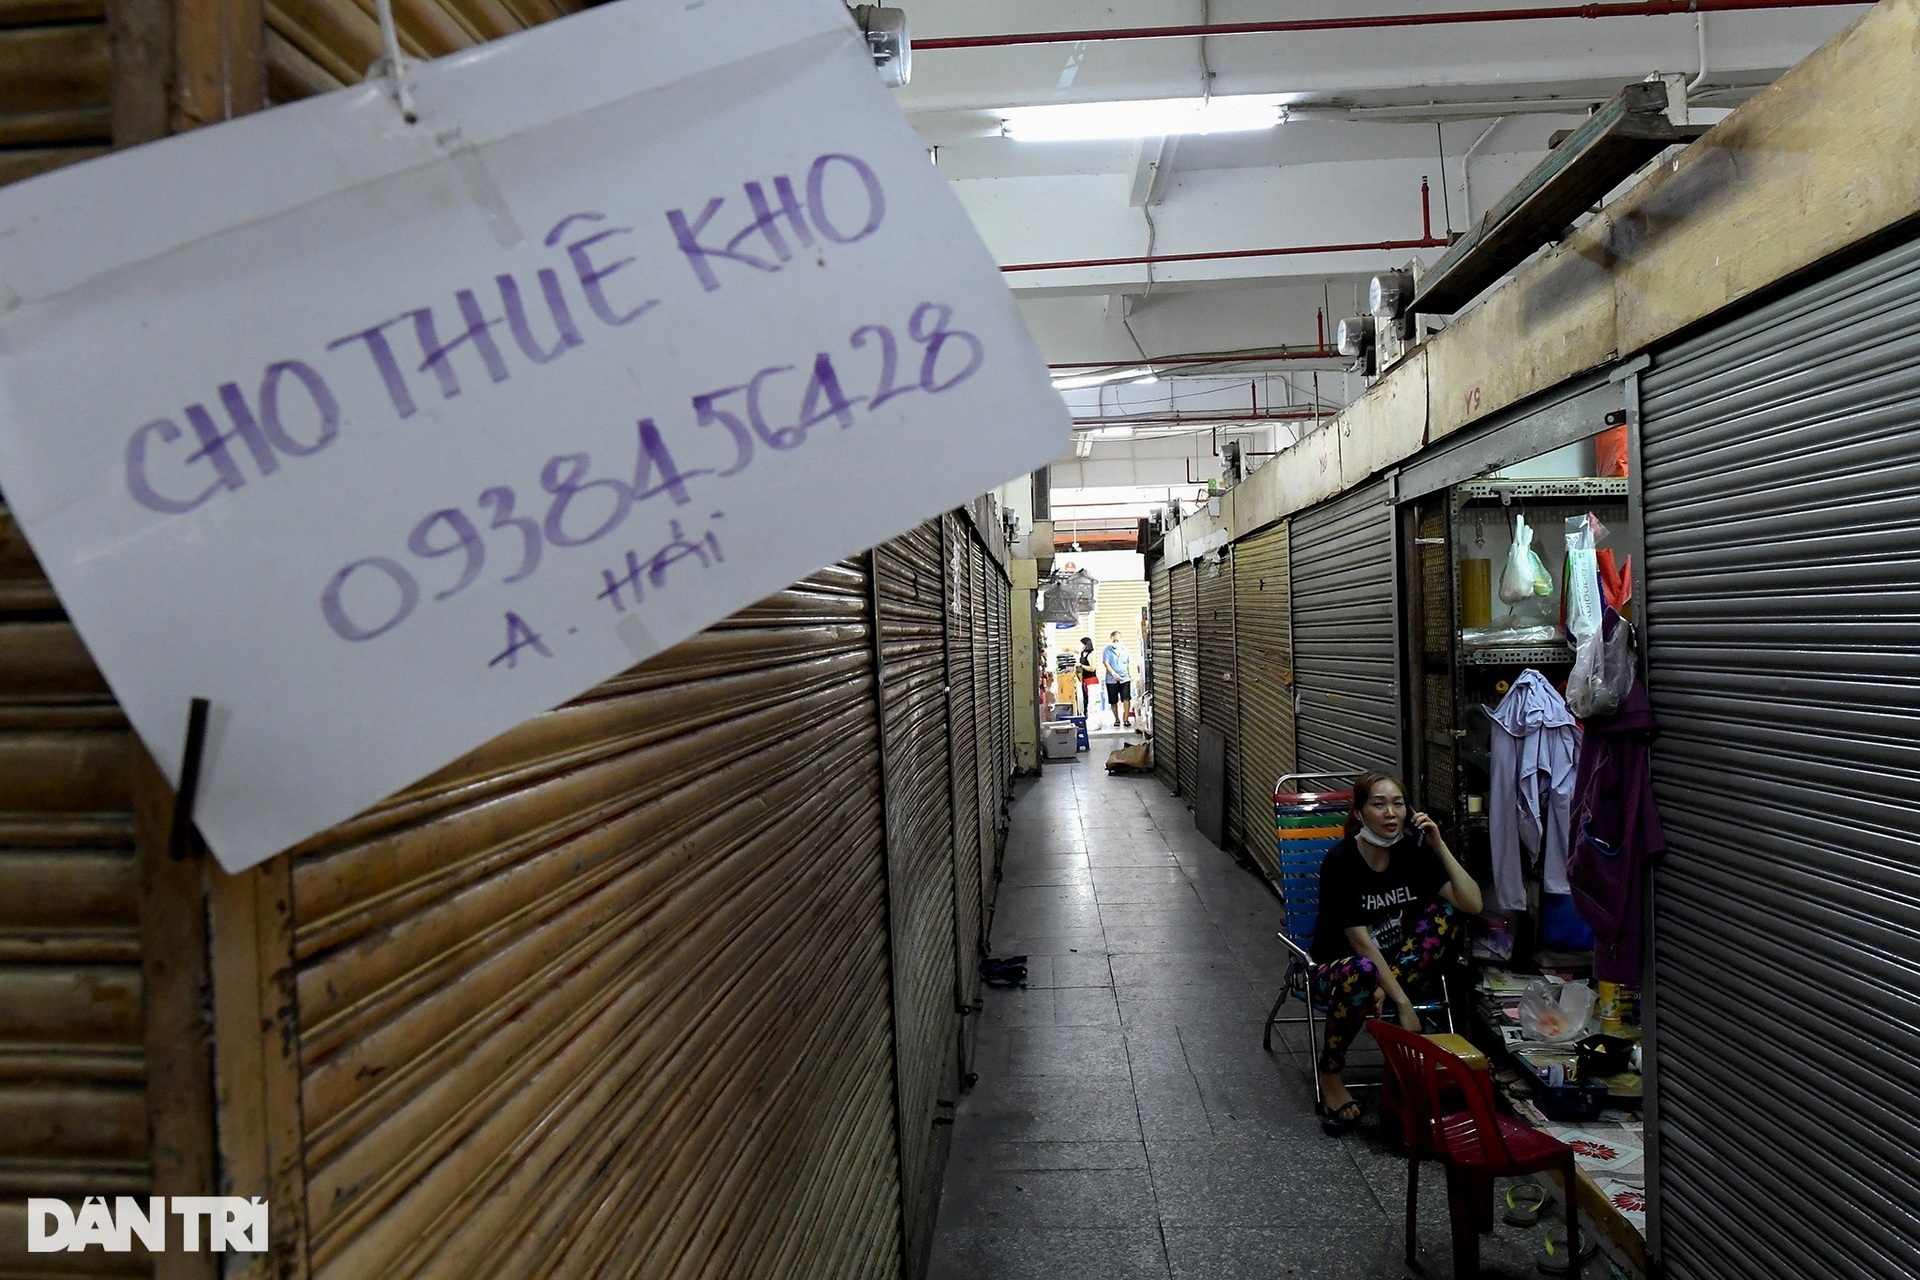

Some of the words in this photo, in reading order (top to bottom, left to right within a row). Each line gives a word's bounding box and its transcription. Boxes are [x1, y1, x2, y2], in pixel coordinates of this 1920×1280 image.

[126, 360, 341, 515] CHO
[328, 212, 661, 422] THUÊ
[668, 154, 886, 294] KHO
[321, 301, 984, 642] 0938456428
[1464, 386, 1481, 415] Y9
